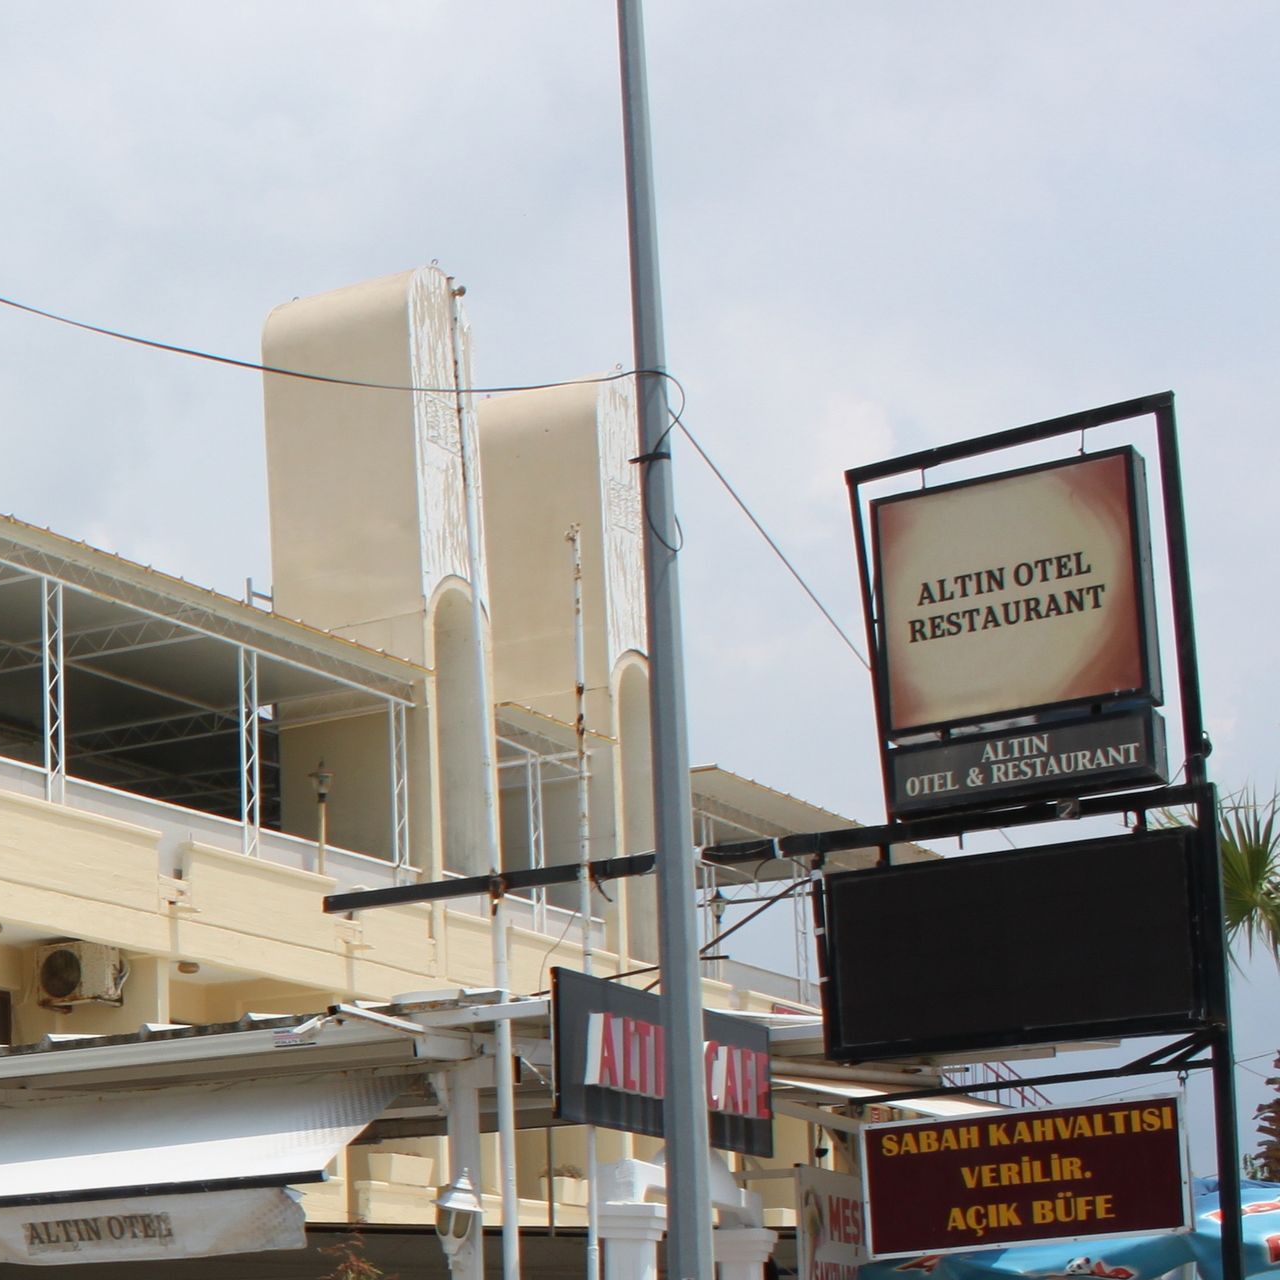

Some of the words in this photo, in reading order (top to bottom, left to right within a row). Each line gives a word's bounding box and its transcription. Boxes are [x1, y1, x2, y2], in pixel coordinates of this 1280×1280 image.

[917, 566, 1006, 607] ALTIN
[1013, 551, 1092, 587] OTEL
[908, 584, 1107, 644] RESTAURANT
[906, 771, 959, 798] OTEL
[966, 765, 984, 788] &
[991, 742, 1140, 786] RESTAURANT
[981, 733, 1050, 763] ALTIN
[704, 1040, 772, 1119] CAFE
[881, 1125, 980, 1157] SABAH
[989, 1106, 1173, 1147] KAHVALTISI
[961, 1153, 1092, 1189] VERİLİR.
[27, 1216, 101, 1244] ALTIN
[107, 1213, 173, 1240] OTEL
[947, 1202, 1022, 1237] AÇIK
[1032, 1191, 1116, 1225] BÜFE
